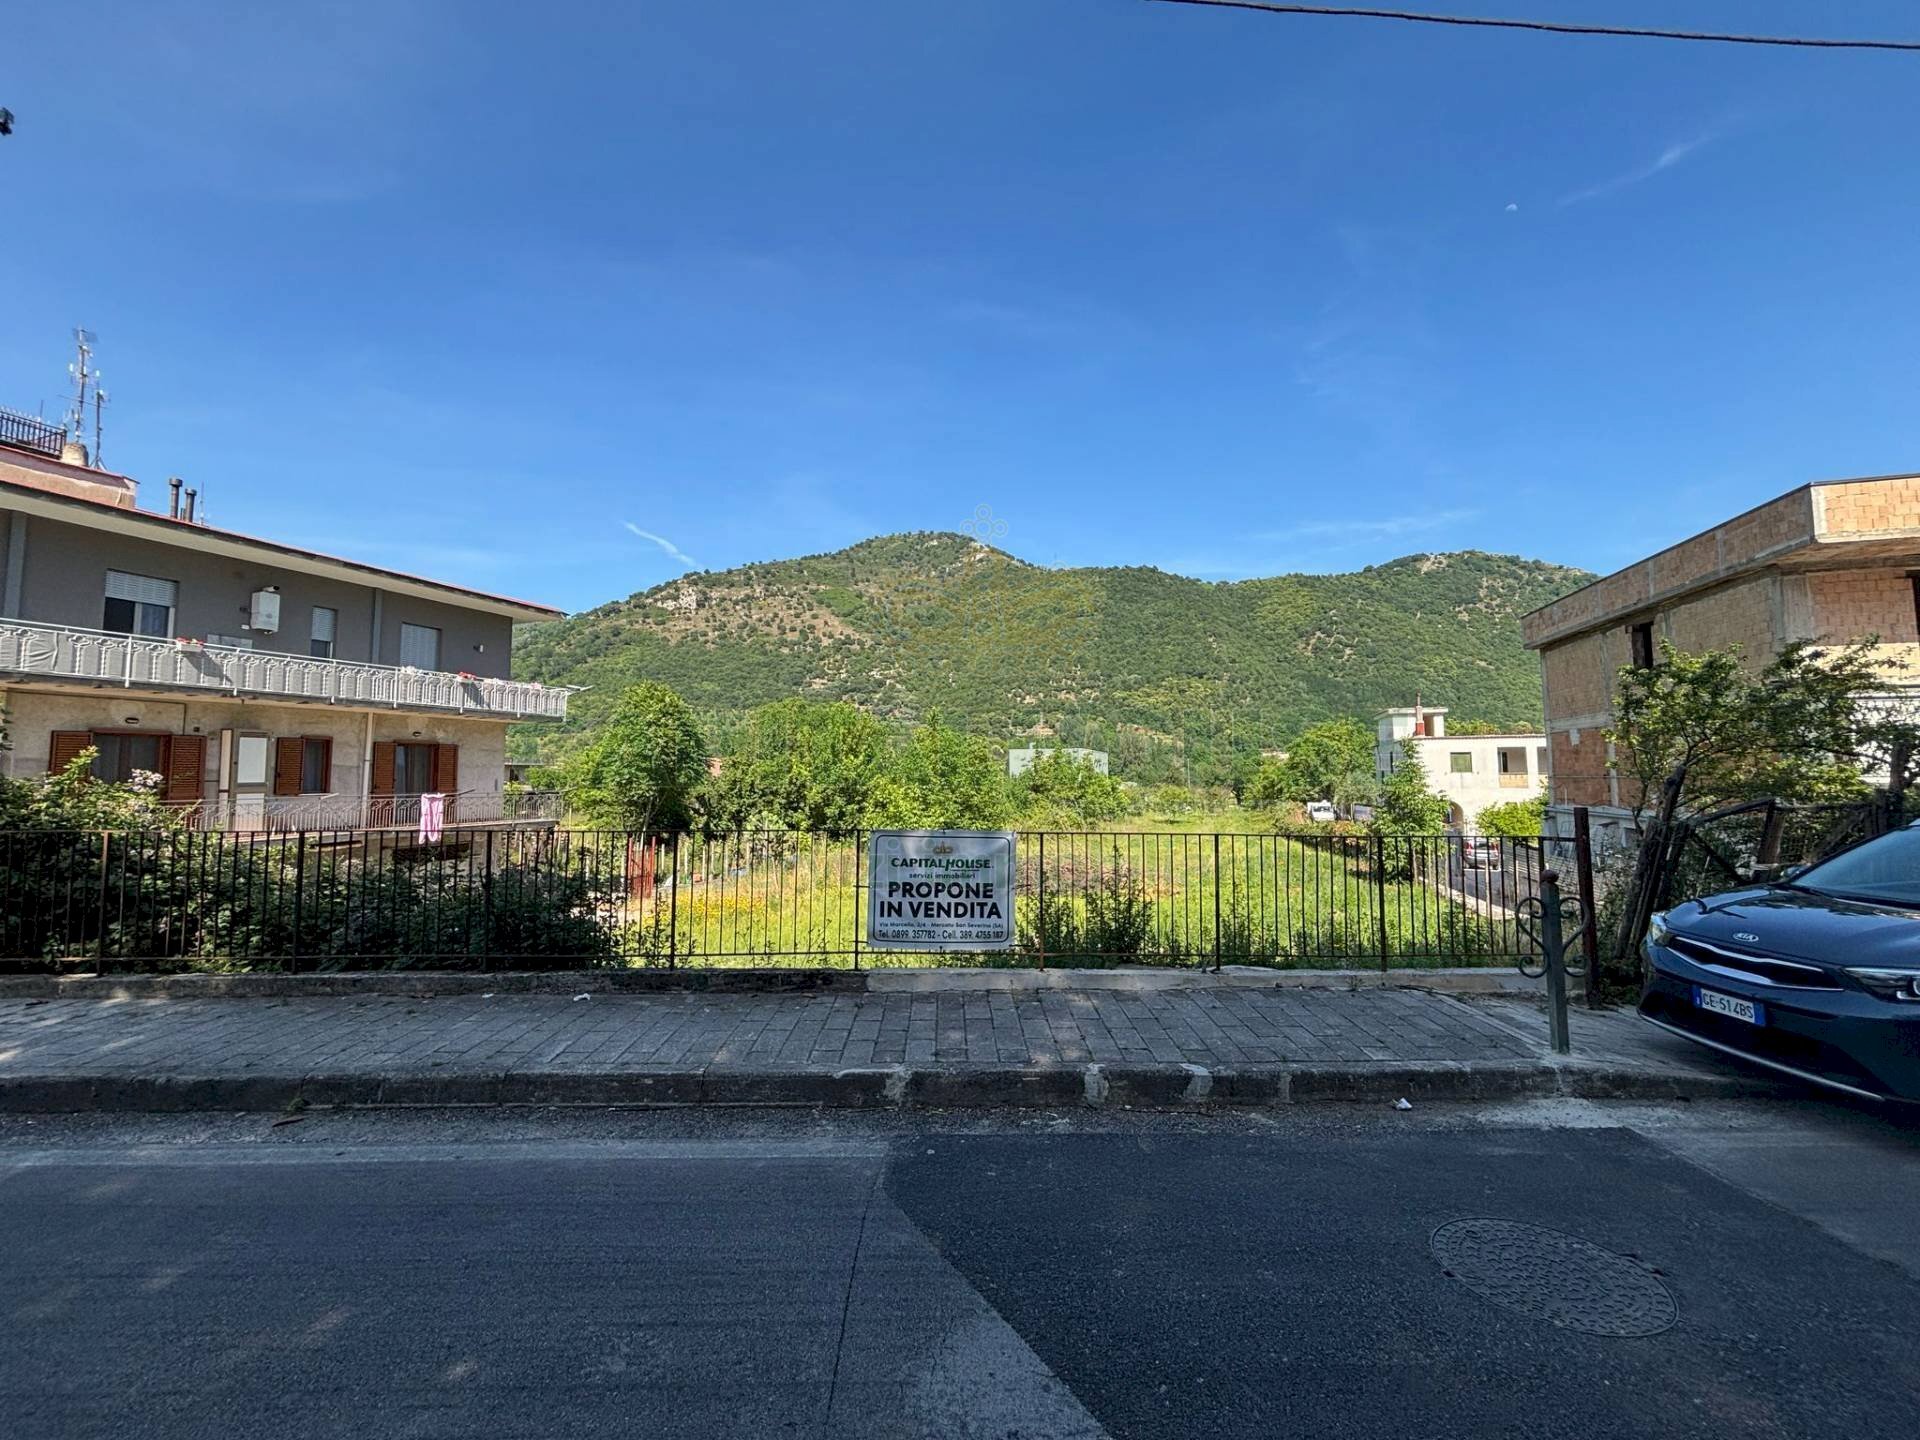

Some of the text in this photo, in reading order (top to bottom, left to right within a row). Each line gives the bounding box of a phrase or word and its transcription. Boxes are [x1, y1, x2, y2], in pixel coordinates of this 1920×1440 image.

[888, 881, 994, 899] PROPONE
[879, 900, 1002, 919] IN VENDITA
[911, 930, 936, 939] 357782
[975, 931, 991, 939] 4755
[1734, 932, 1756, 942] KIA
